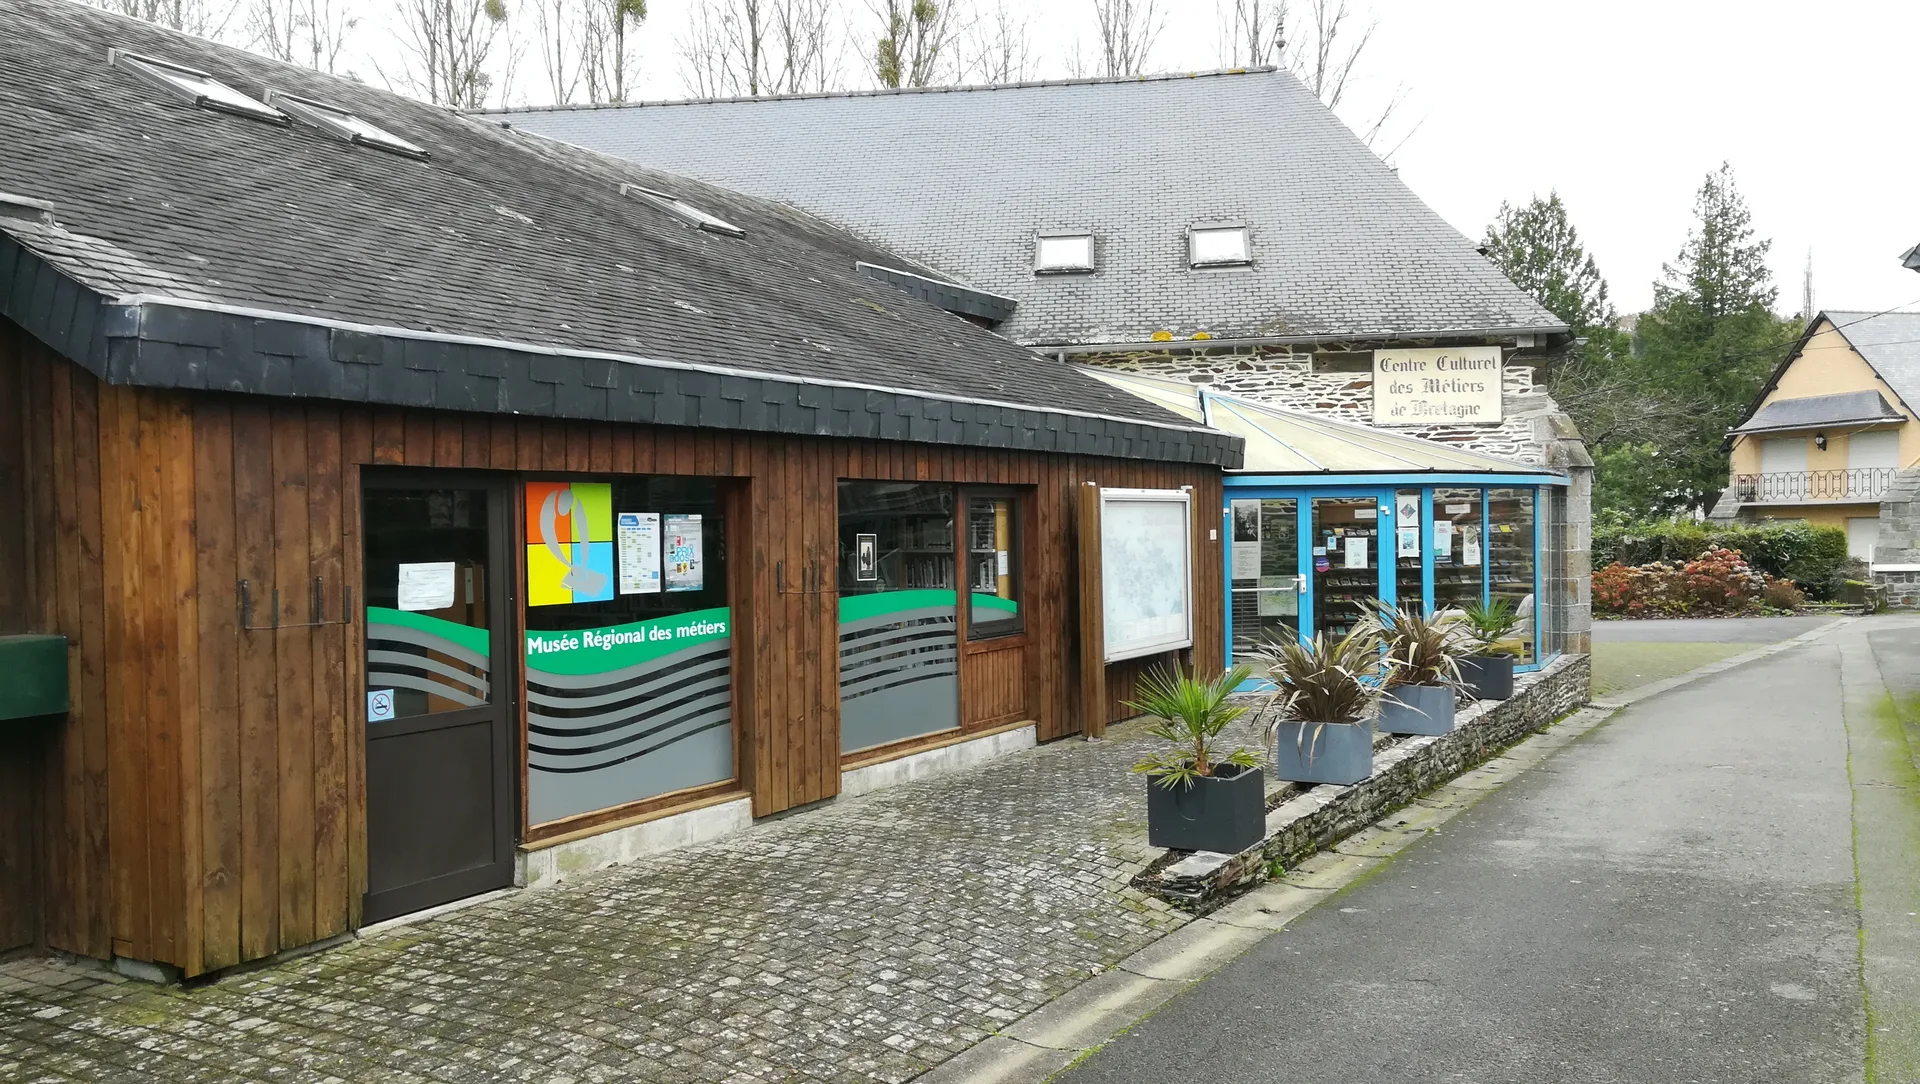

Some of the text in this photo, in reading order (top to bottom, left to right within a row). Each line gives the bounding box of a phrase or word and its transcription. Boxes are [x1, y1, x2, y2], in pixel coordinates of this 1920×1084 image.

[1380, 355, 1497, 373] Centre Culturel
[1389, 378, 1485, 394] des Métiers
[1390, 400, 1481, 418] de Bretagne
[527, 621, 726, 655] Musée Régional des métiers
